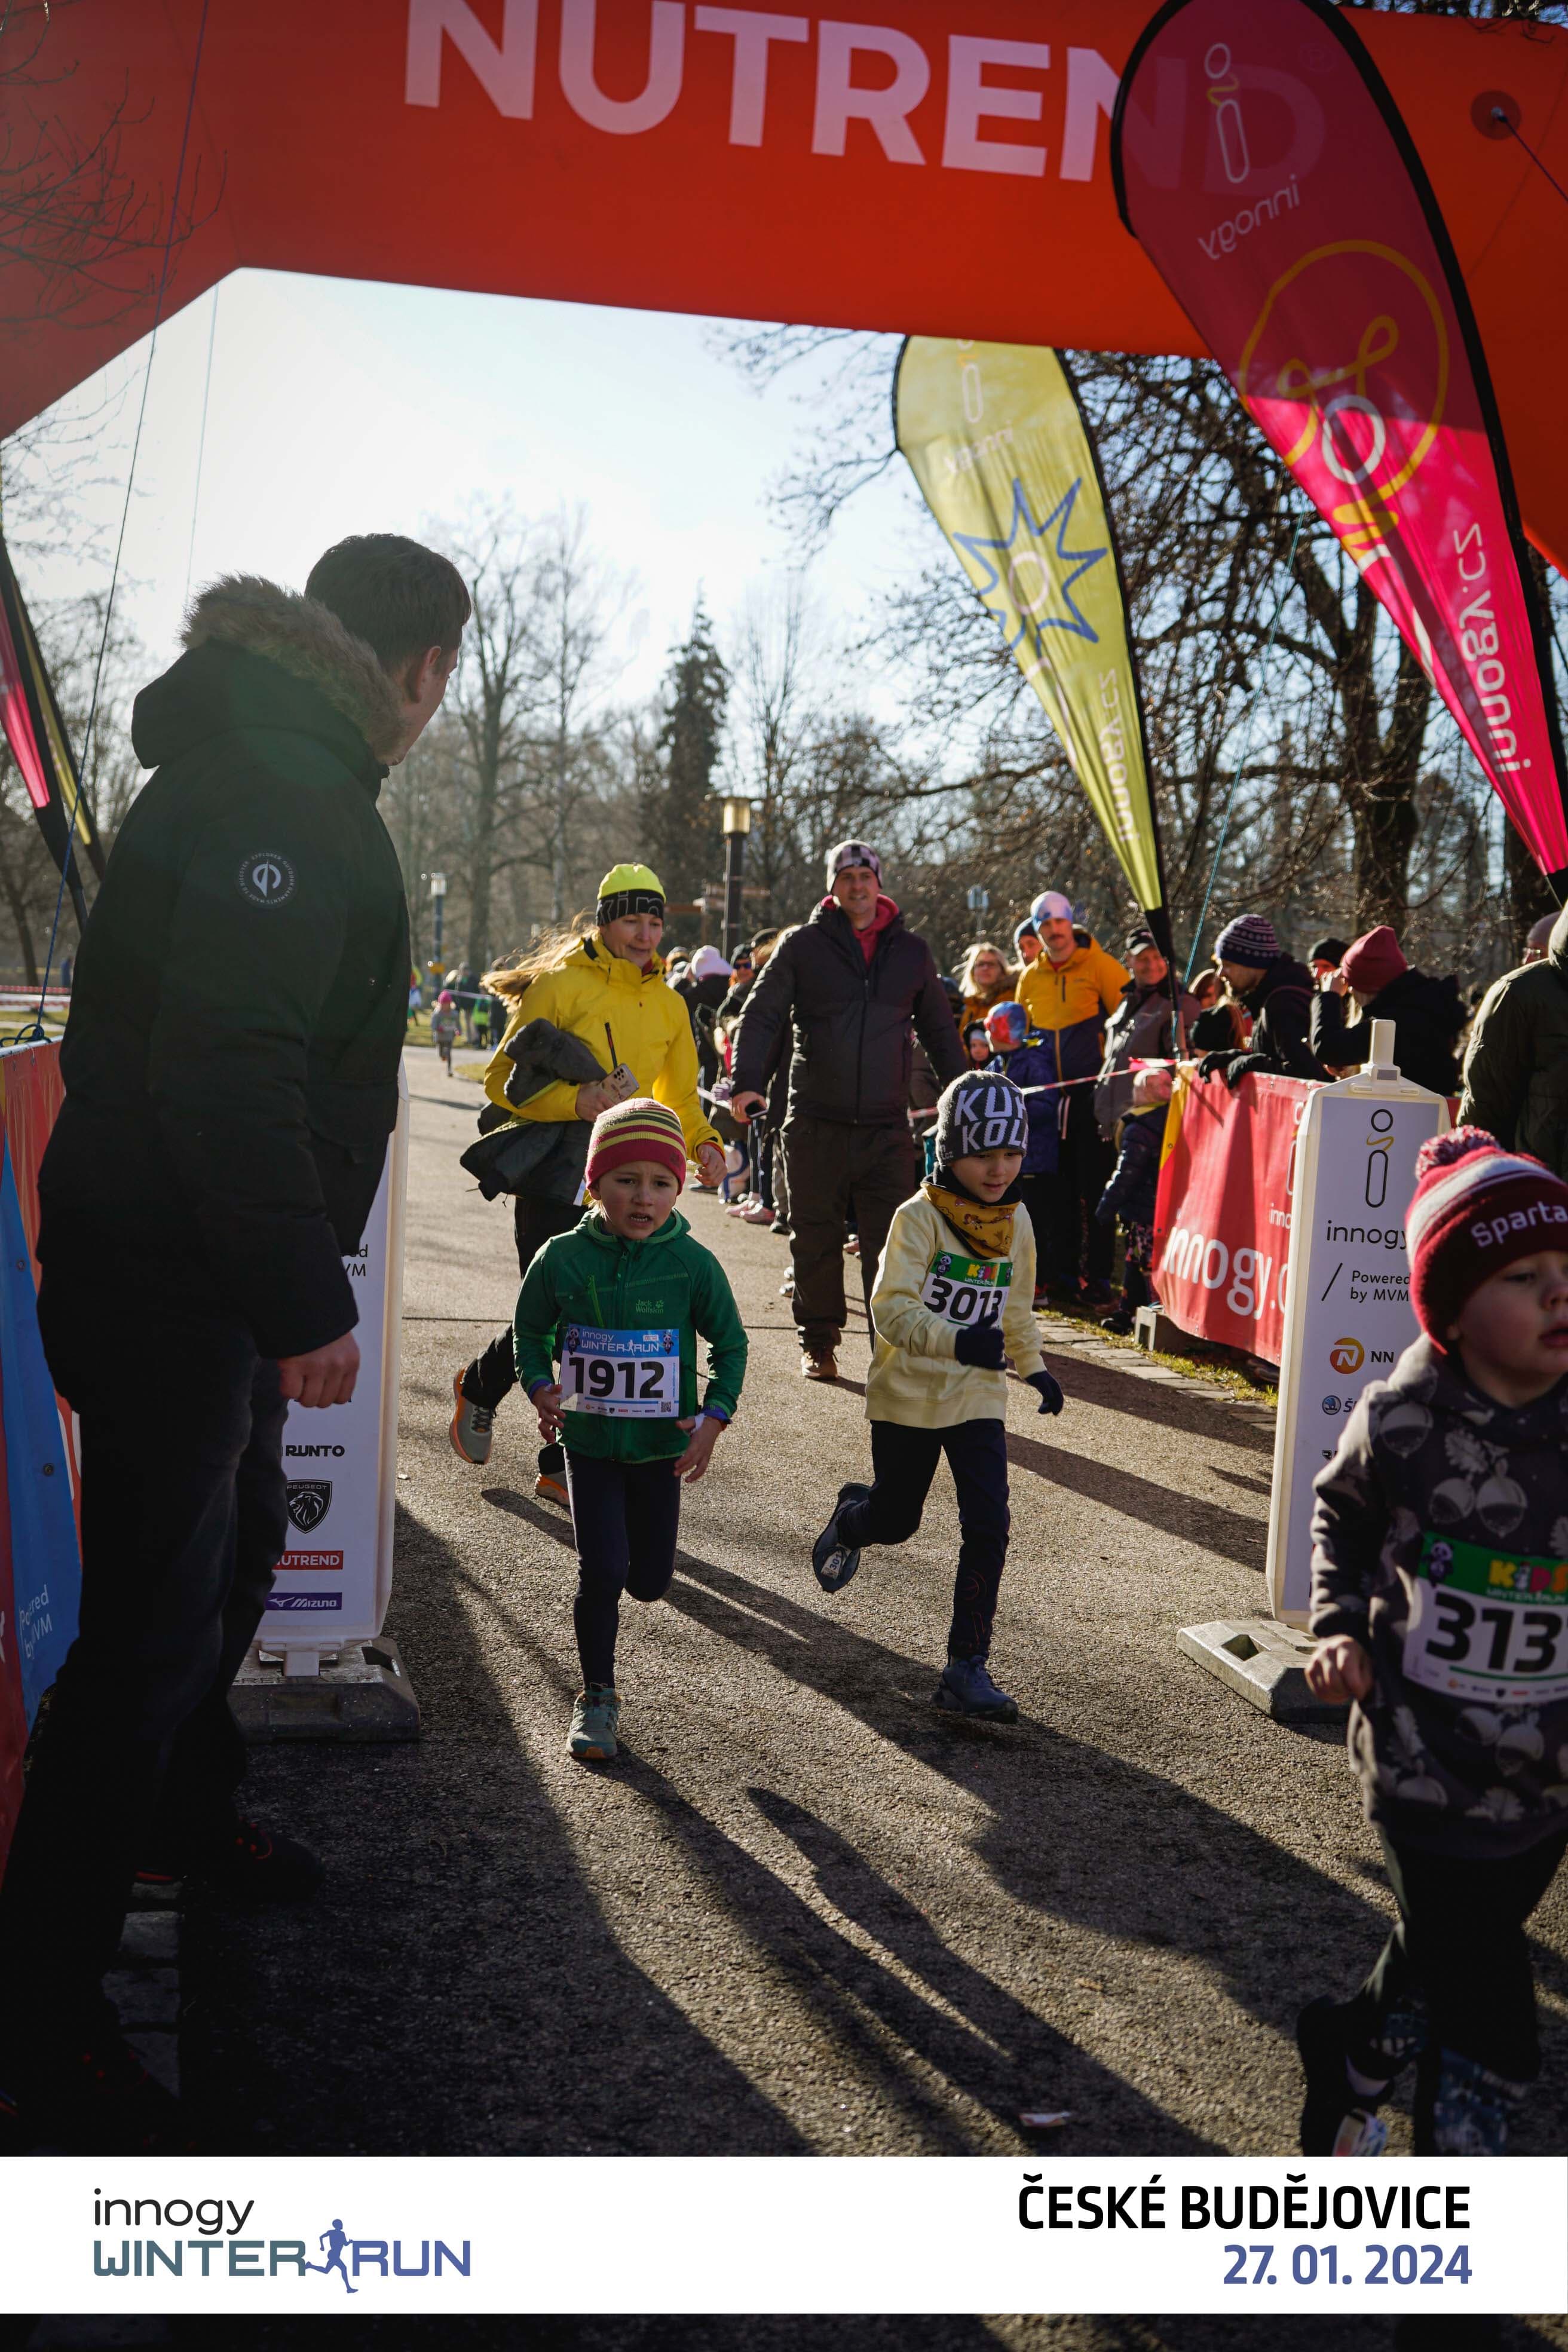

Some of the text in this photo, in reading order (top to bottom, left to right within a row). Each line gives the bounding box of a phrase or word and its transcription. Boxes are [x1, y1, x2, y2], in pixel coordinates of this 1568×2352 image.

[1352, 1270, 1411, 1285] Powered
[1350, 1287, 1409, 1303] by MVM
[582, 1328, 615, 1342] innogy
[581, 1340, 659, 1352] WINTER RUN
[1371, 1350, 1394, 1363] NN
[569, 1356, 664, 1399] 1912
[285, 1444, 345, 1457] RUNTO
[1425, 1591, 1568, 1674] 313
